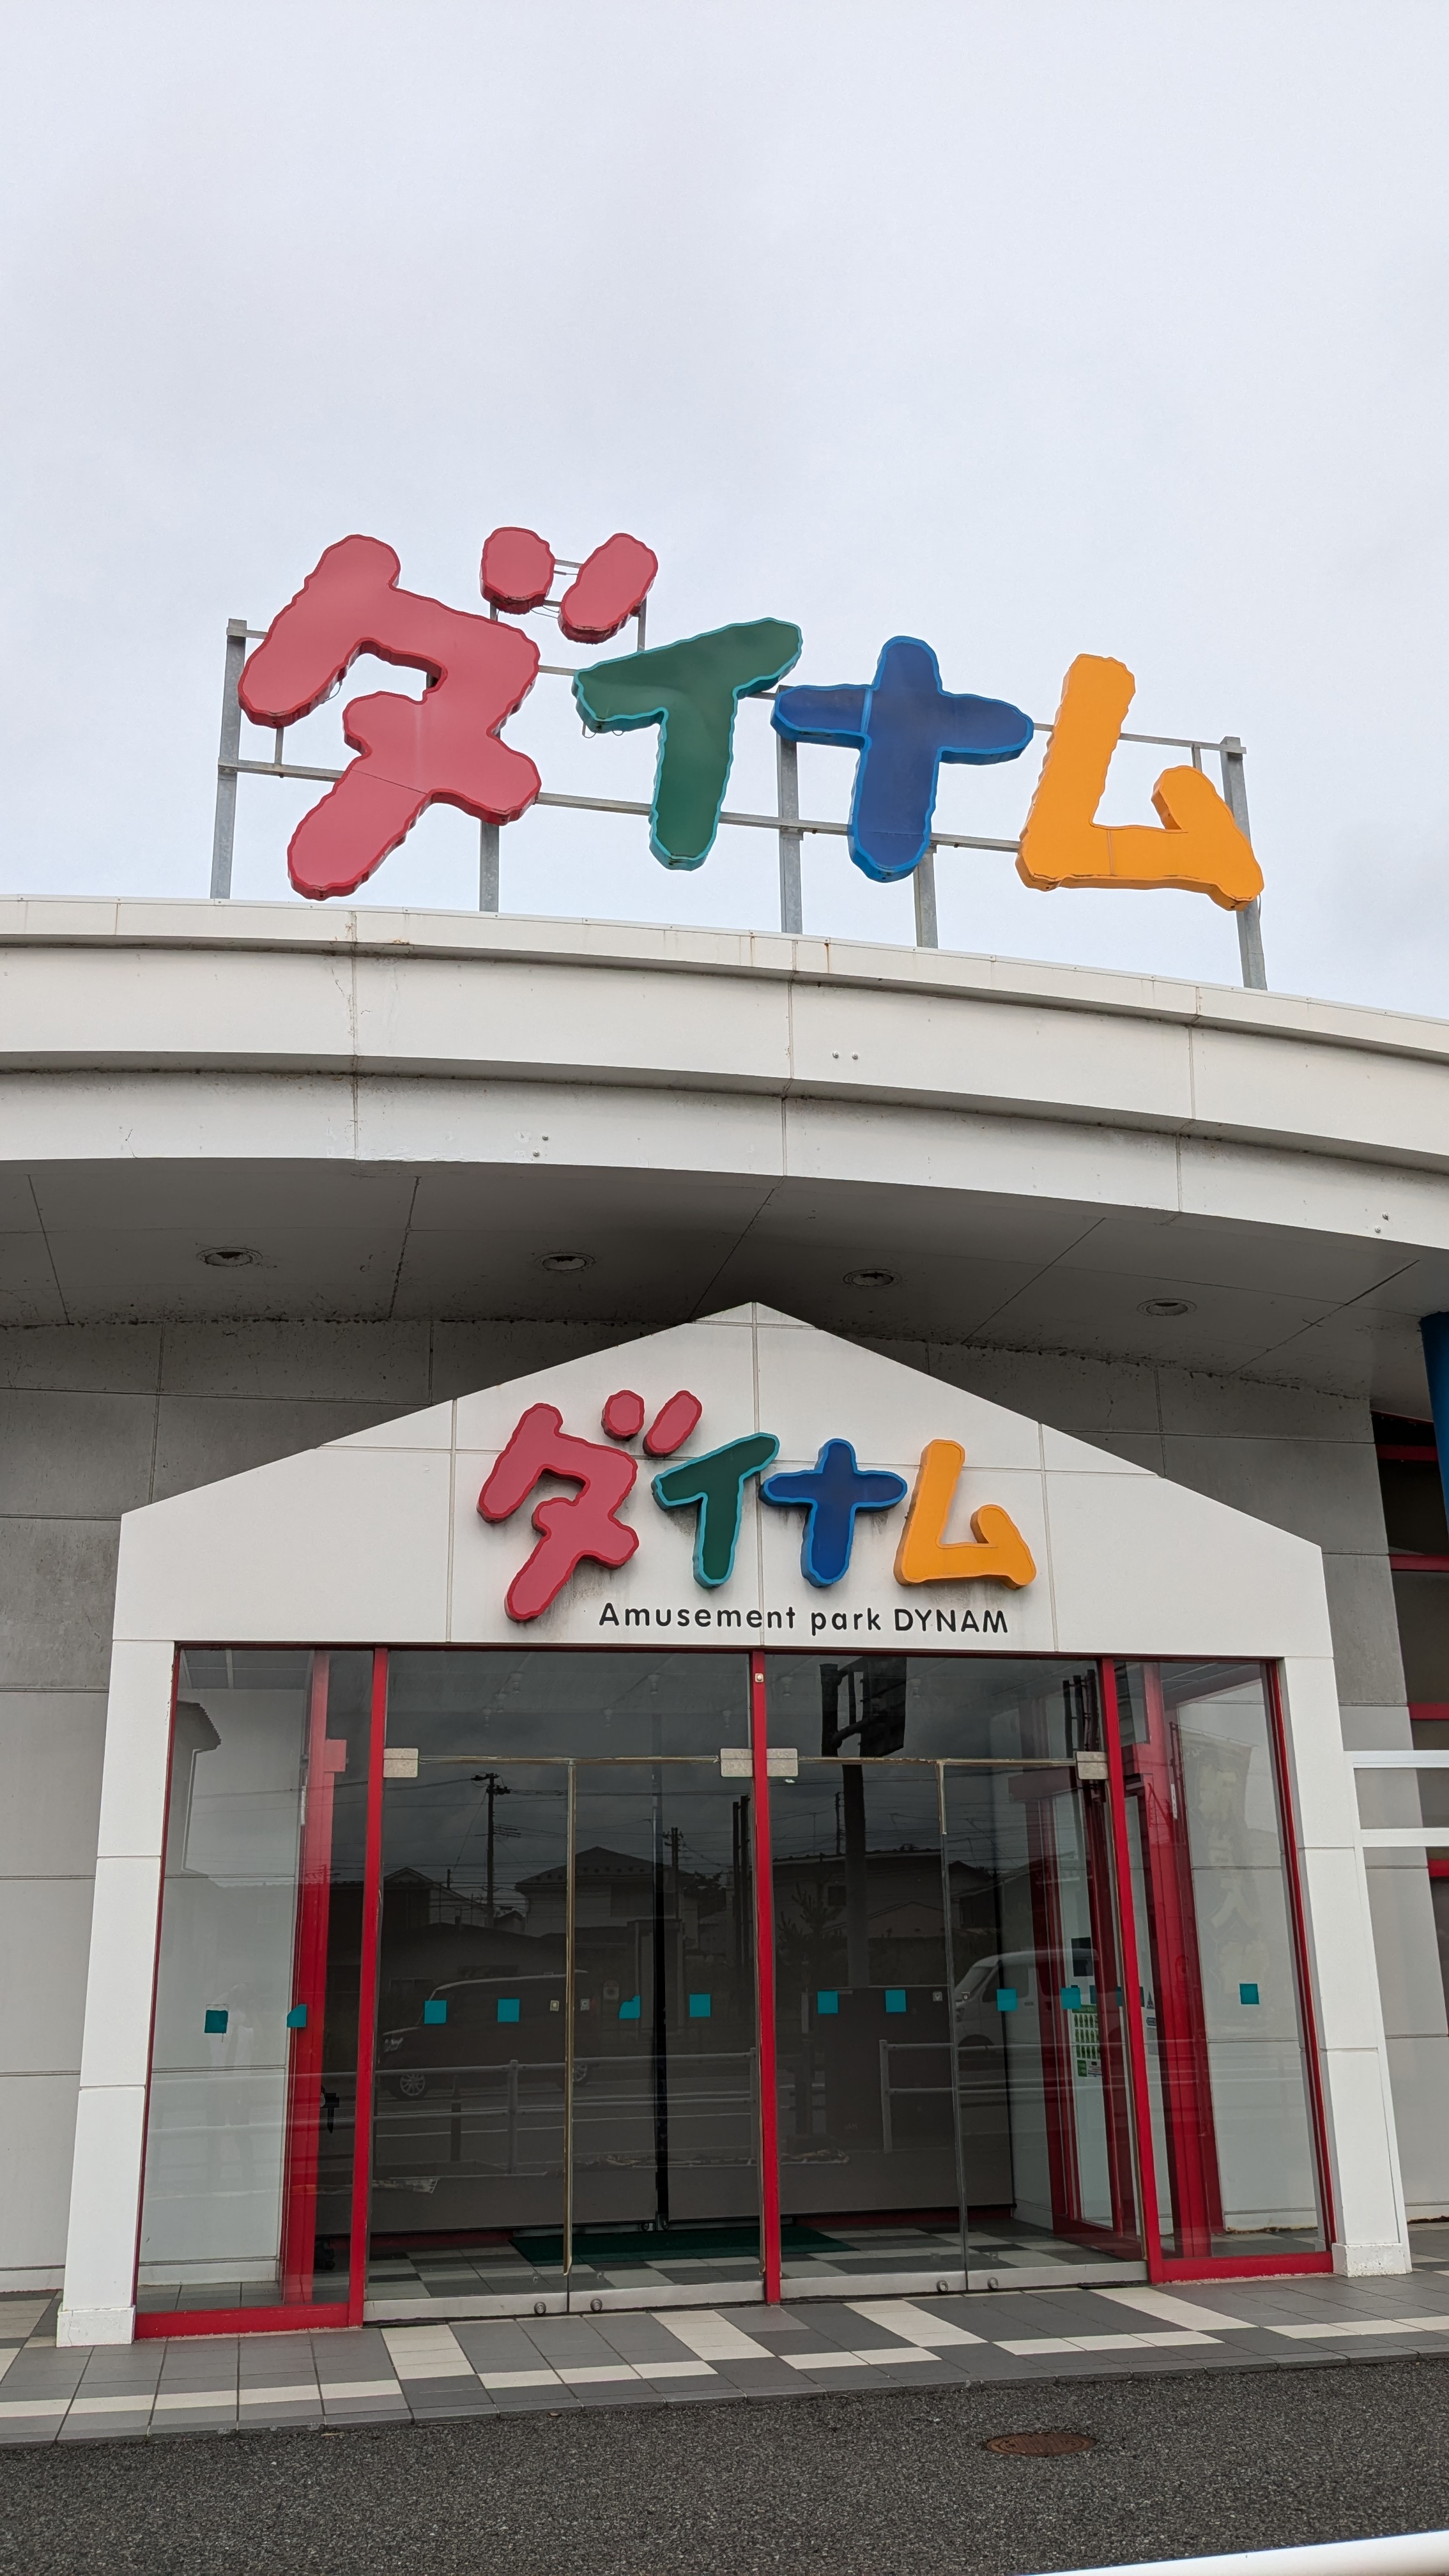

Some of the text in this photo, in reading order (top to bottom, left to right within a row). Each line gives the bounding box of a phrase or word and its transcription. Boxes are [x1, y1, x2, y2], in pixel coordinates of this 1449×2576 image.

[238, 526, 1264, 912] ダイナム
[476, 1390, 1037, 1623] ダイナム
[599, 1602, 1008, 1636] Amusement park DYNAM
